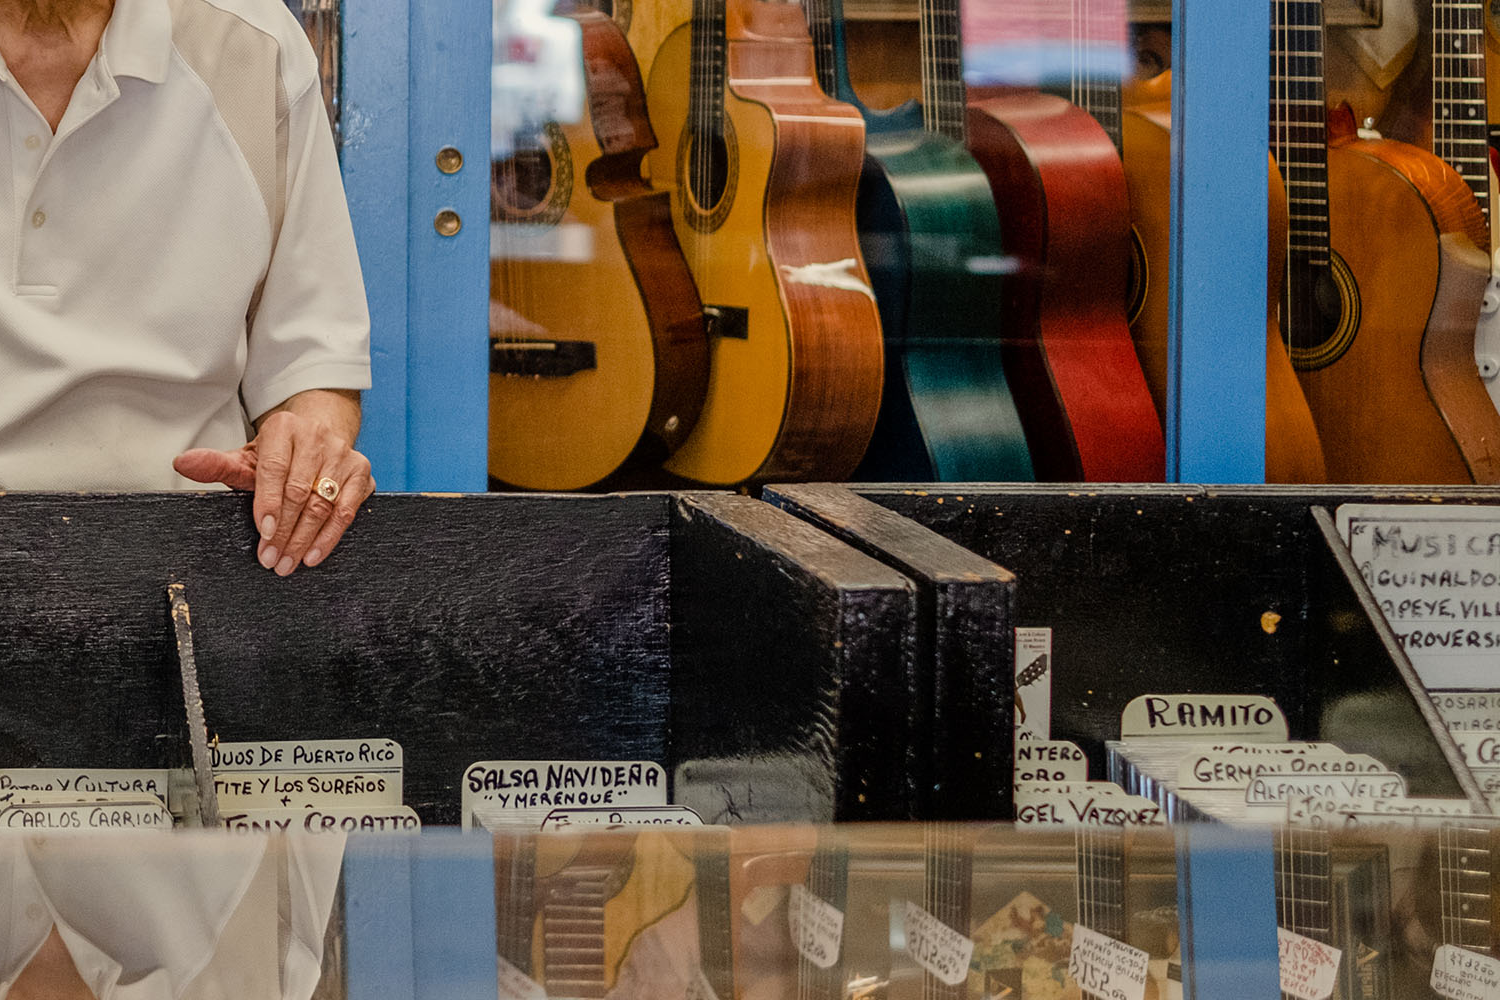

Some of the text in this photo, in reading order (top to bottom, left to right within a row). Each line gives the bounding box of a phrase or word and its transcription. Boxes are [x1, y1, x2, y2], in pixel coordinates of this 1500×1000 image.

[1145, 697, 1274, 729] RAMITO
[259, 746, 284, 767] DE
[293, 744, 355, 765] PUERTO
[56, 778, 71, 792] Y
[74, 774, 159, 793] CULTURA
[257, 777, 271, 794] Y
[274, 775, 305, 794] LOS
[306, 774, 387, 796] SUREÑOS
[467, 762, 660, 793] SALSA NAVIDEÑA
[1341, 777, 1400, 799] VELEZ
[7, 807, 165, 829] CARLOS CARRION
[224, 810, 420, 836] TONY CROATTO
[1068, 797, 1166, 826] VAZQUEZ
